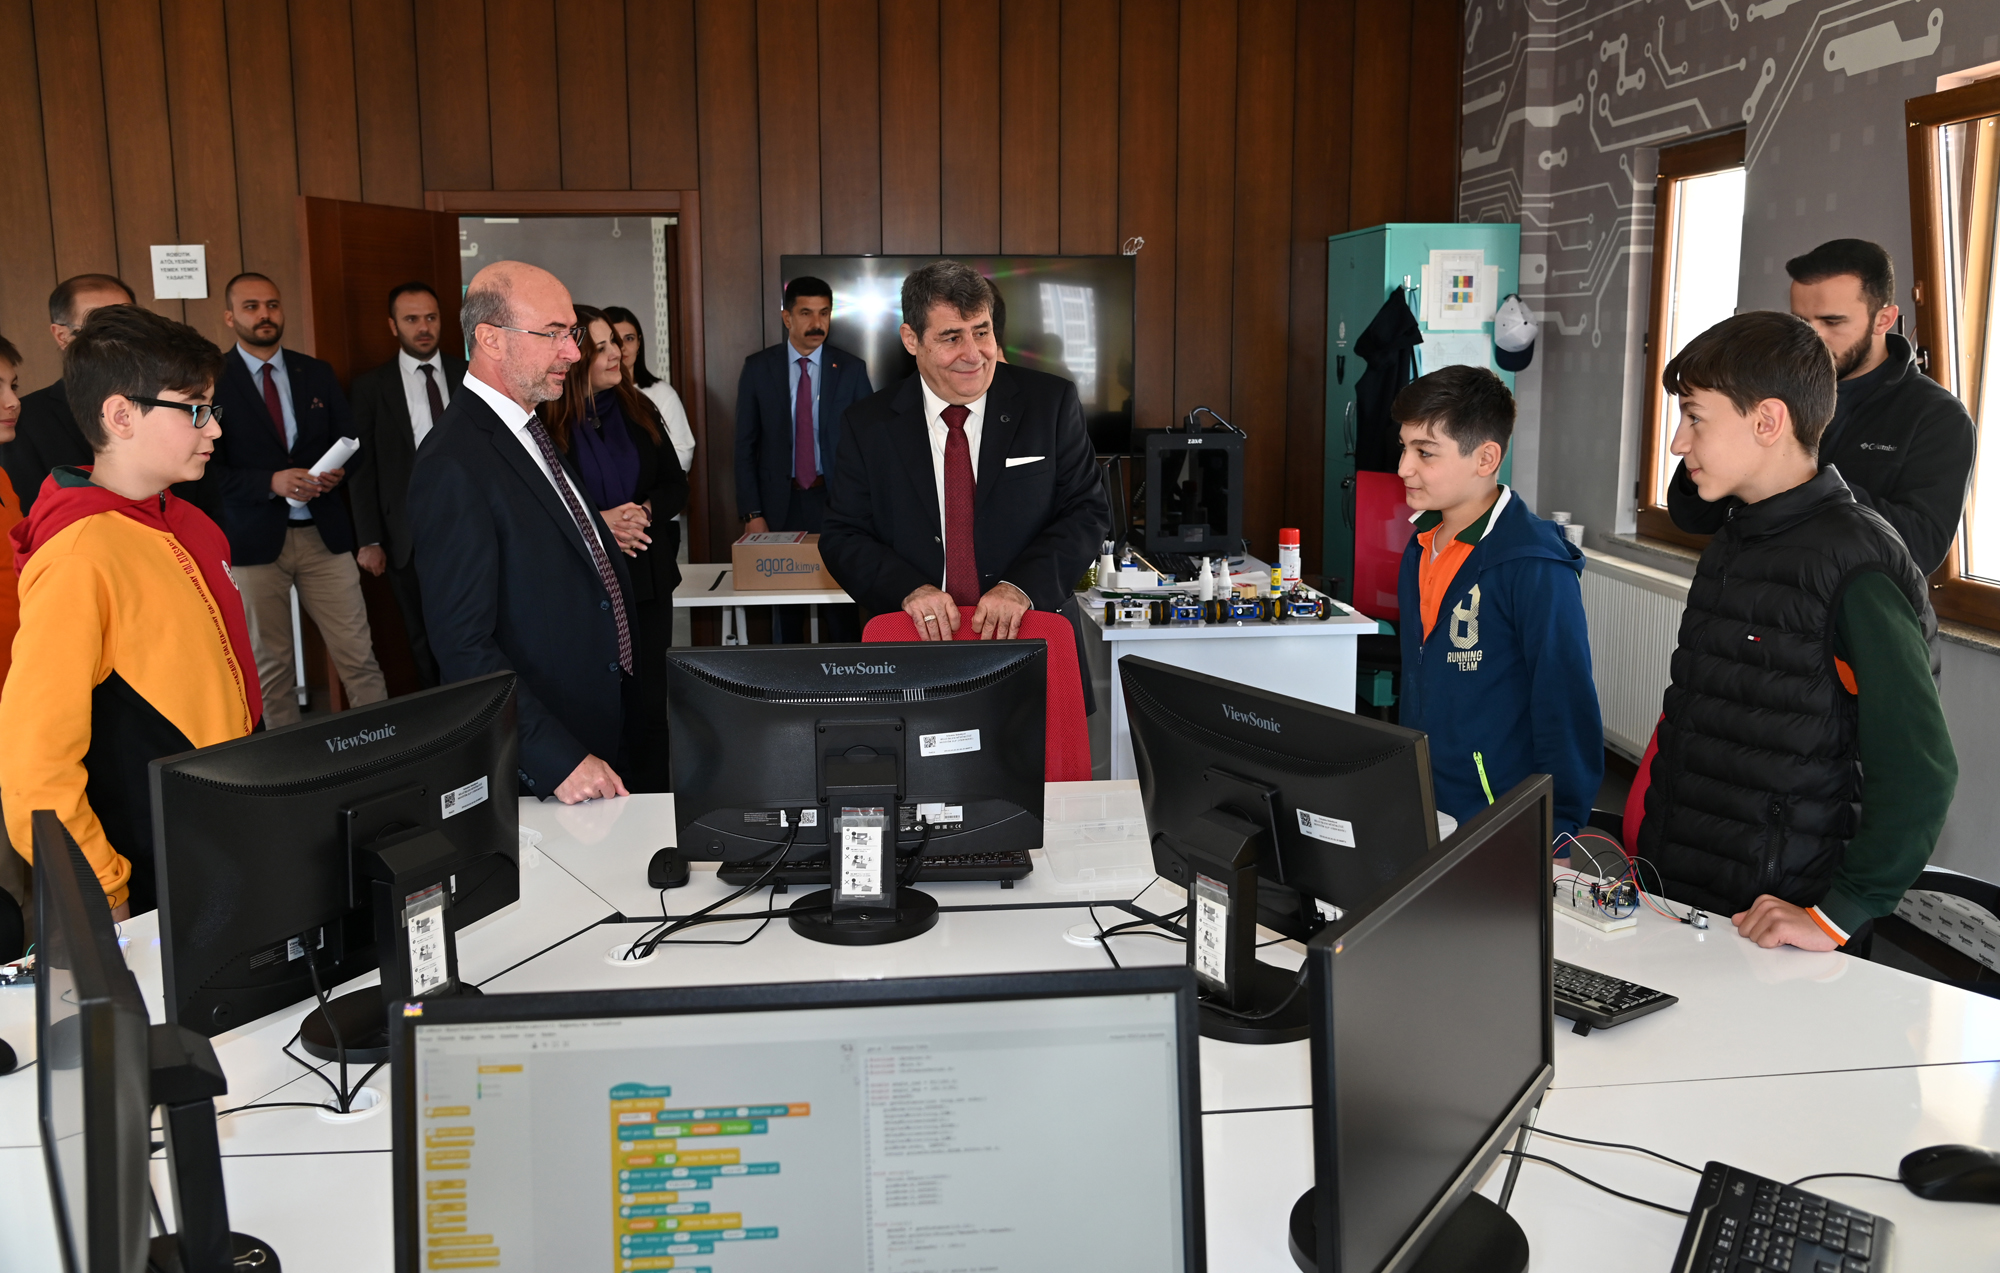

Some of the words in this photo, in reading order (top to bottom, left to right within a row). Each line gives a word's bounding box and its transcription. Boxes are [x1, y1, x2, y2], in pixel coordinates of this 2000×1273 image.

[756, 558, 794, 577] agora
[796, 561, 820, 573] kimya
[1446, 650, 1483, 662] RUNNING
[820, 662, 896, 675] ViewSonic
[1458, 661, 1478, 672] TEAM
[1222, 703, 1281, 734] ViewSonic
[325, 723, 396, 754] ViewSonic
